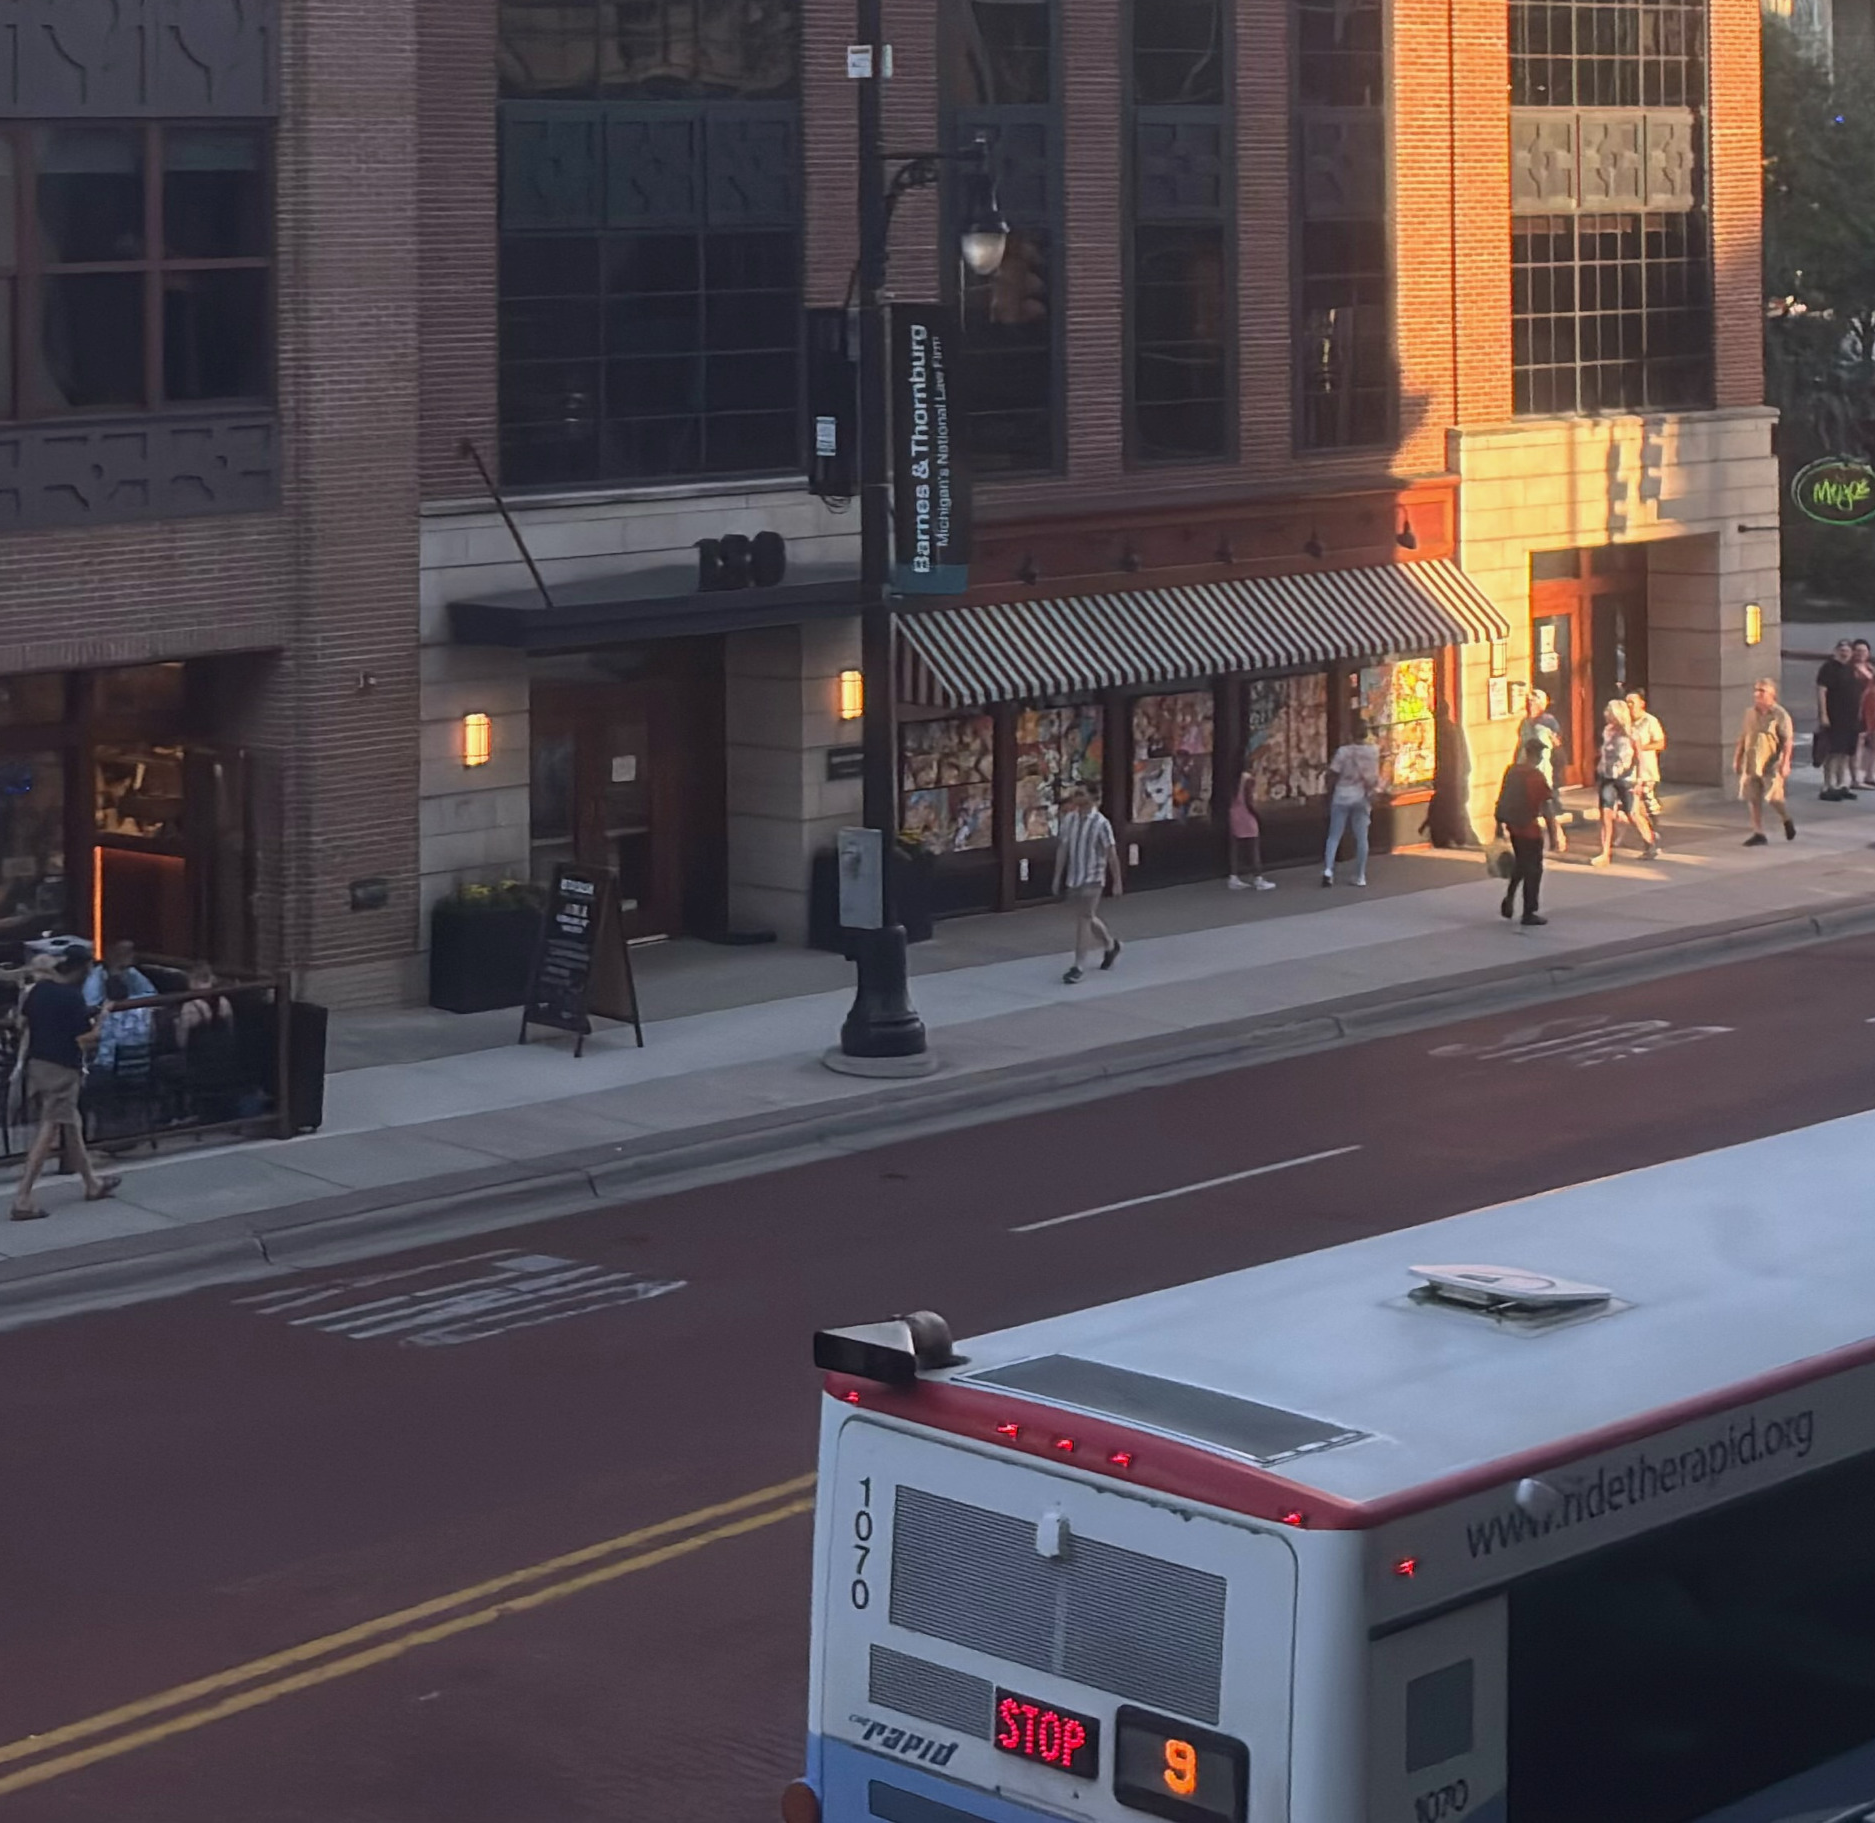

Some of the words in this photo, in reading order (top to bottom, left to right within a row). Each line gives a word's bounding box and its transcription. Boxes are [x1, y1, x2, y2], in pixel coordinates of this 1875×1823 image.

[908, 325, 930, 457] Thornburg
[934, 372, 948, 401] Law
[935, 404, 949, 464] National
[911, 459, 930, 479] &
[912, 484, 931, 573] Barnes
[935, 469, 952, 547] Michigan's
[850, 1477, 874, 1611] 1070
[862, 1721, 959, 1766] rapid
[996, 1696, 1087, 1769] STOP
[1162, 1737, 1199, 1796] 9
